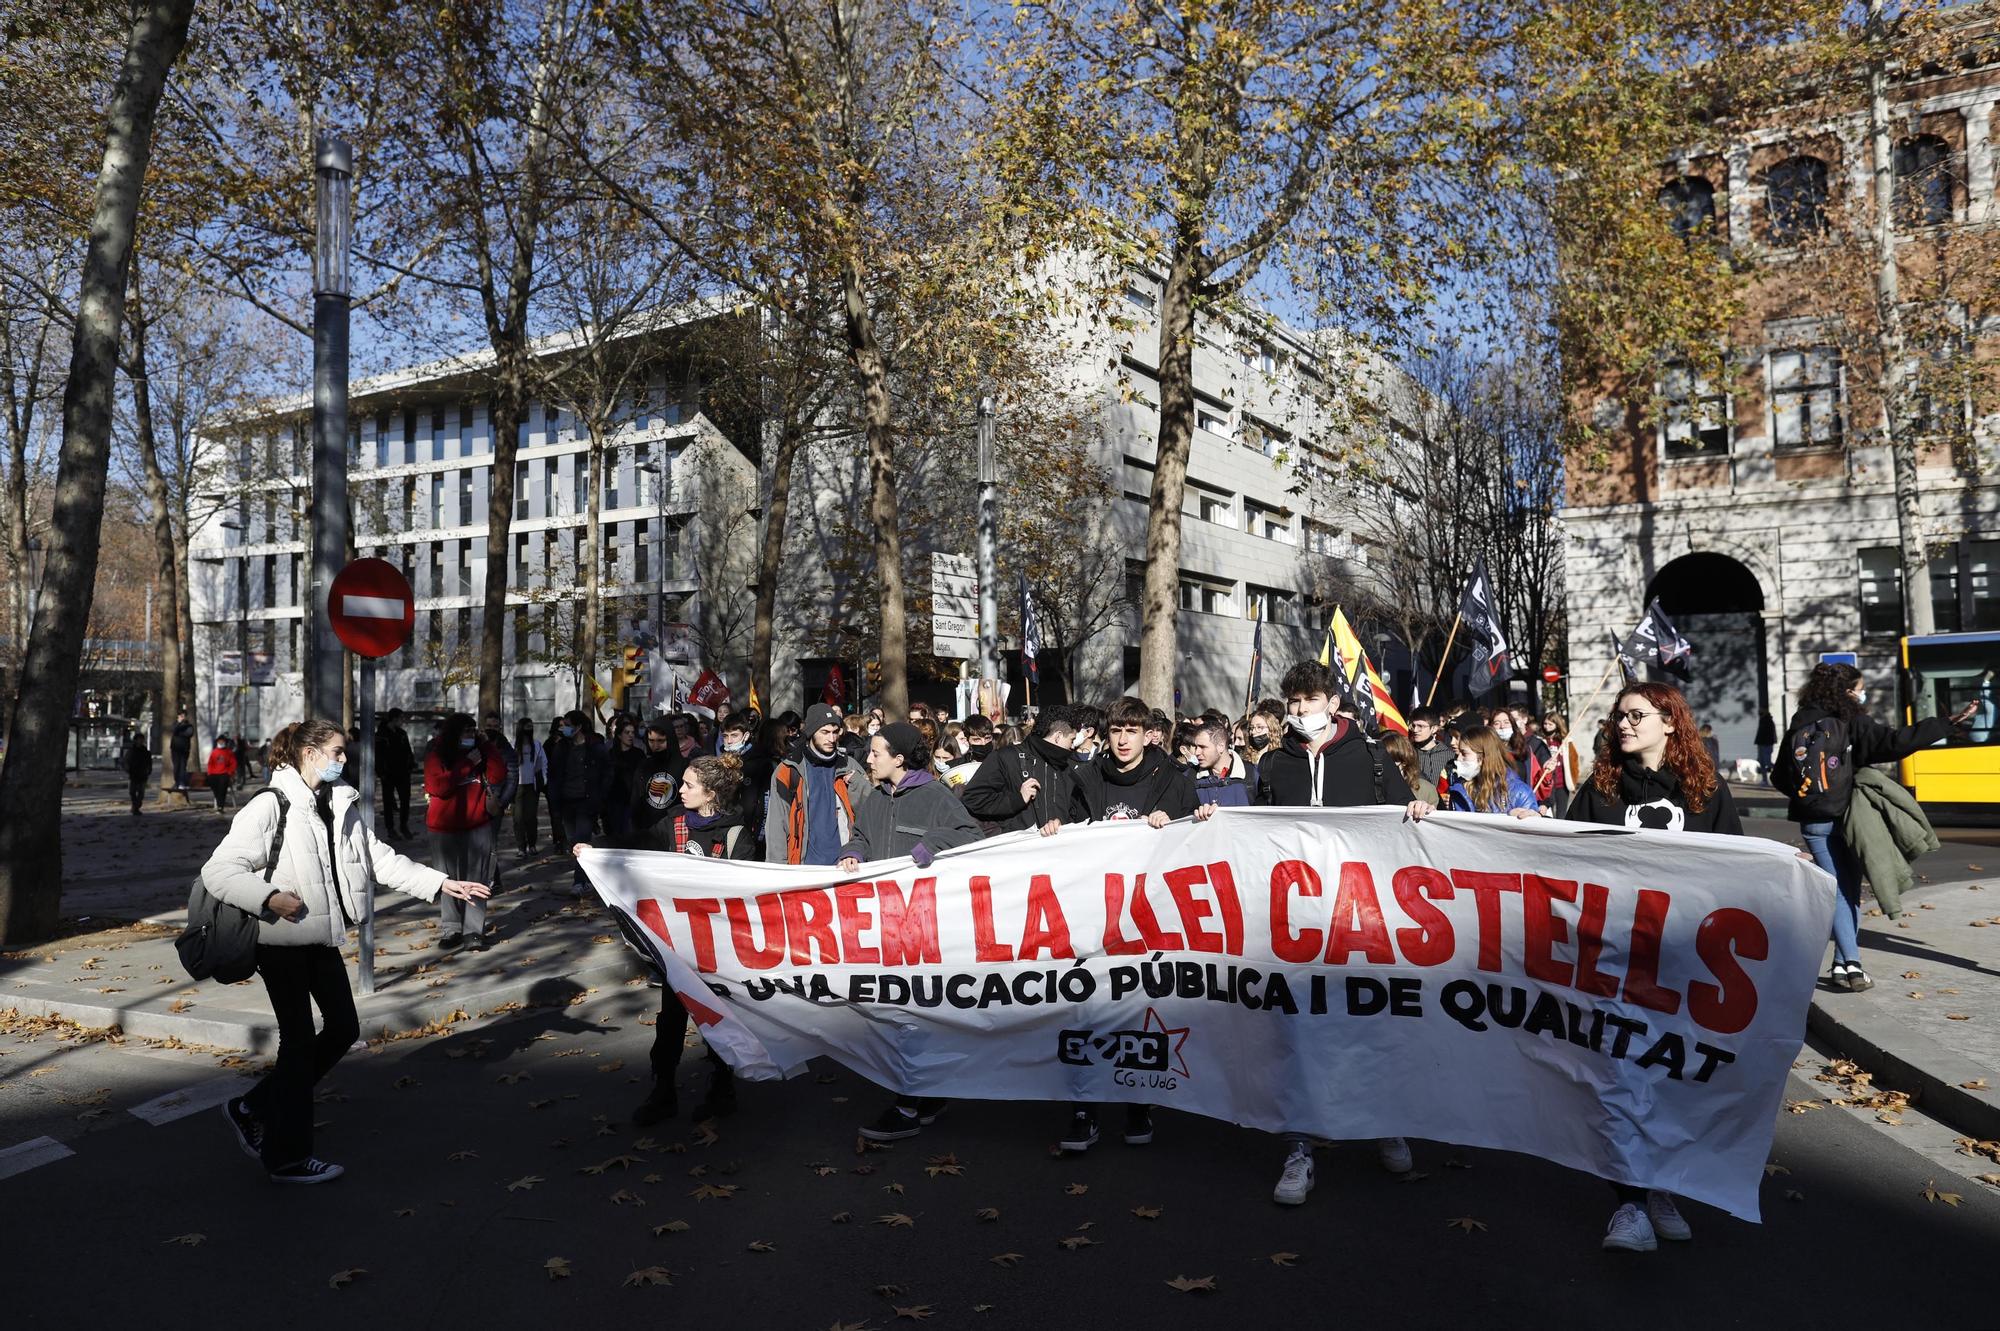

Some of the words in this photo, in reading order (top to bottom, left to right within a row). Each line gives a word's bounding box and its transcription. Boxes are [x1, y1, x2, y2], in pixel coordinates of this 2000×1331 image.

[934, 578, 953, 591] Bany
[935, 619, 946, 630] Sant
[969, 873, 1069, 964] LA
[1103, 860, 1244, 957] LLEI
[1269, 859, 1769, 1034] CASTELLS
[848, 959, 1096, 1009] EDUCACIÓ
[1110, 951, 1298, 1015] PÚBLICA
[1310, 974, 1327, 1015] I
[1346, 976, 1424, 1018] DE
[1440, 979, 1737, 1083] QUALITAT
[1113, 1069, 1137, 1088] CG
[1149, 1073, 1177, 1091] UdG
